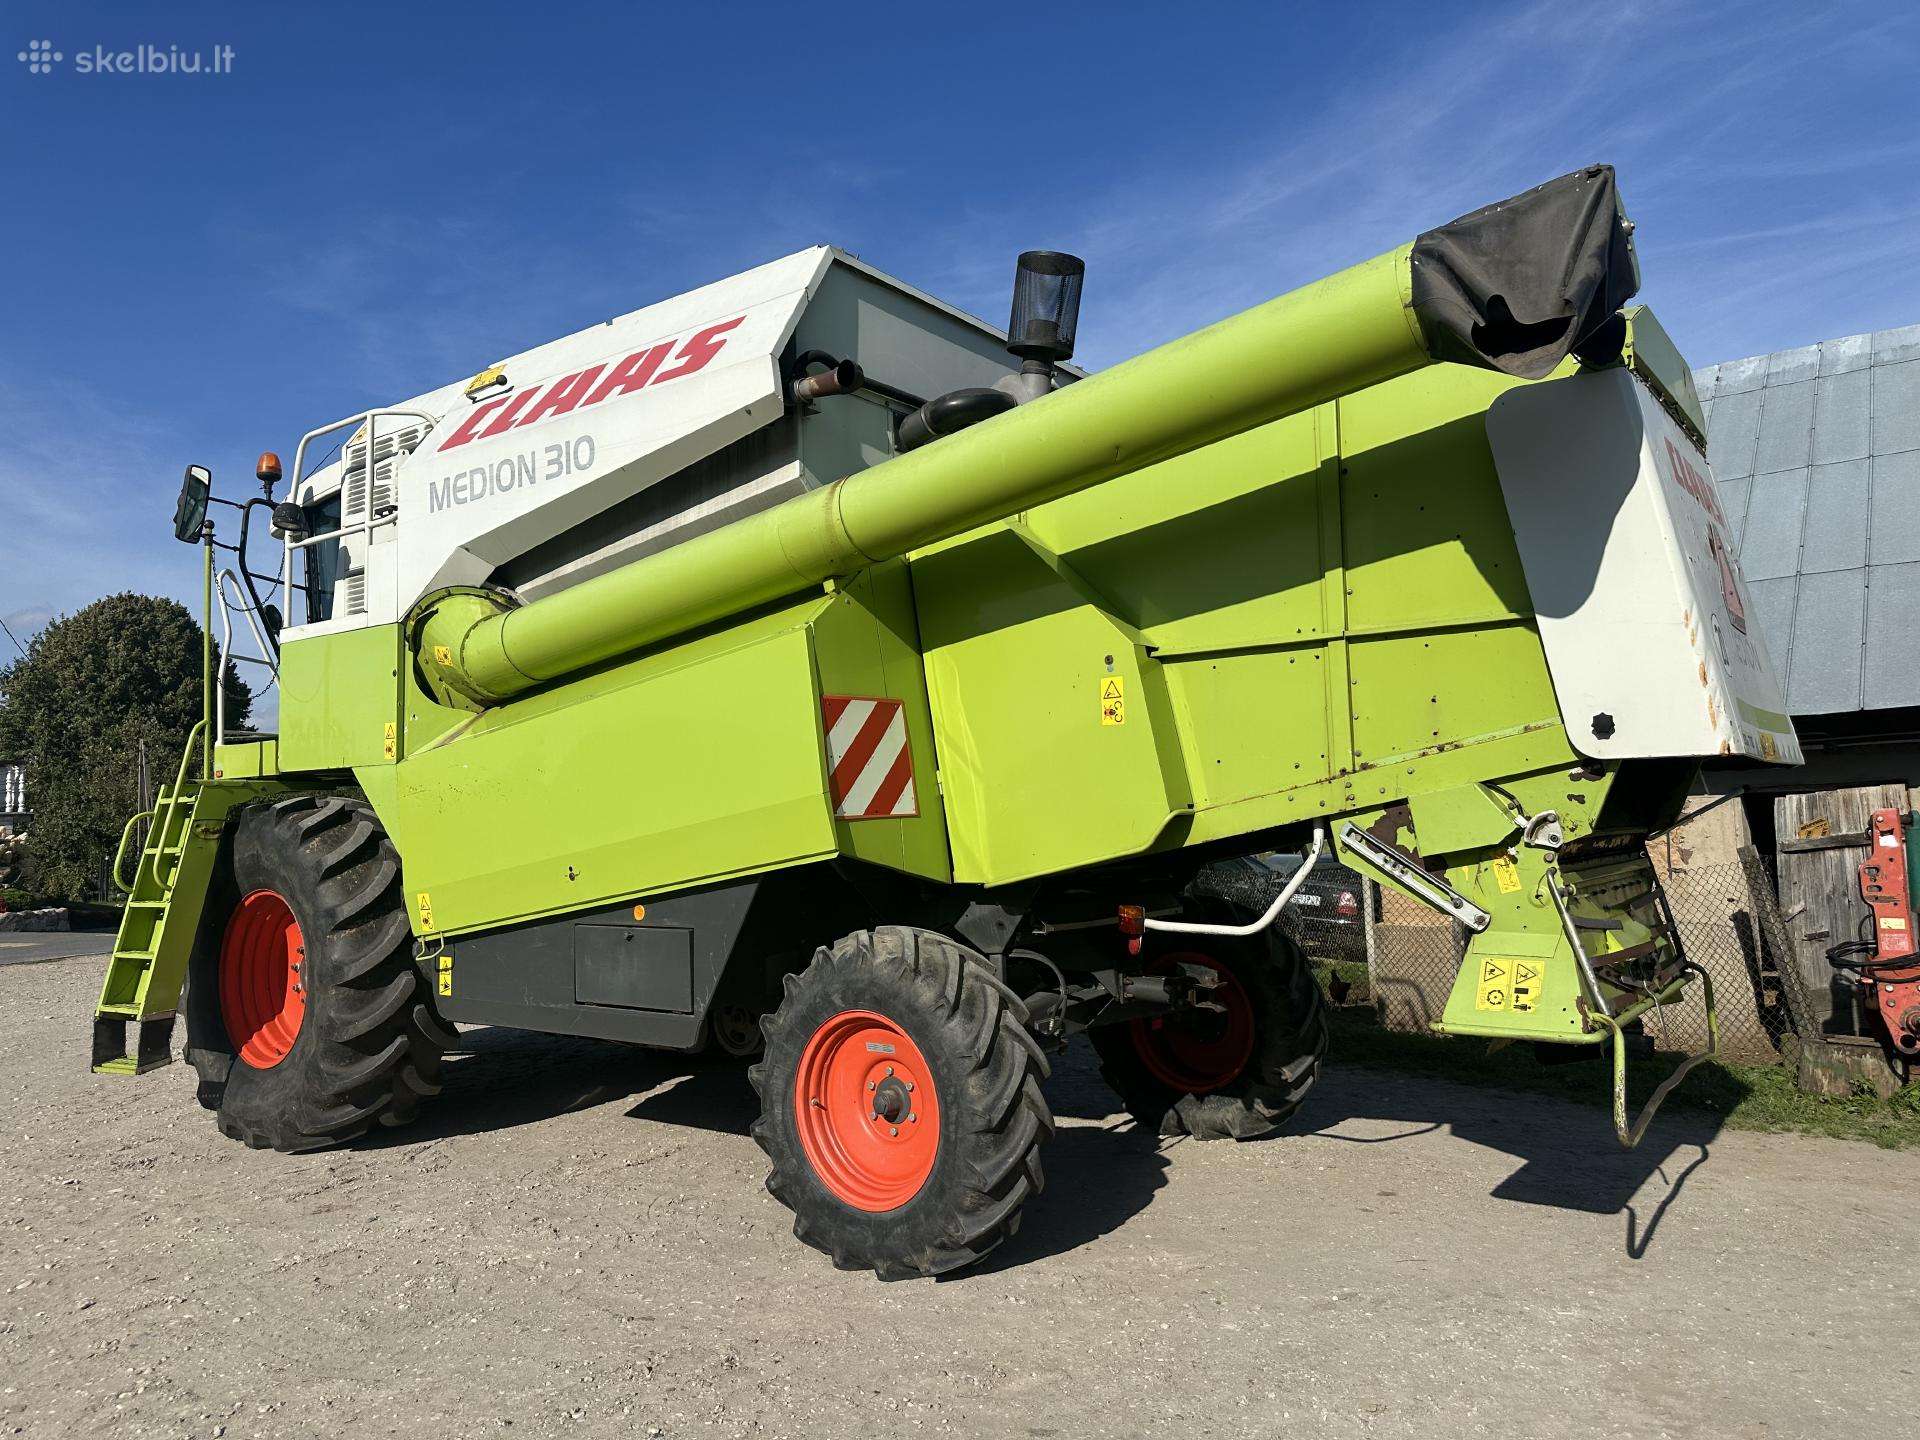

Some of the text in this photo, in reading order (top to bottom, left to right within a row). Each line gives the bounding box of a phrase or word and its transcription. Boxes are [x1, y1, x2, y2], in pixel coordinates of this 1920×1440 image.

[437, 315, 747, 452] CLAAS
[429, 435, 596, 513] MEDION 310
